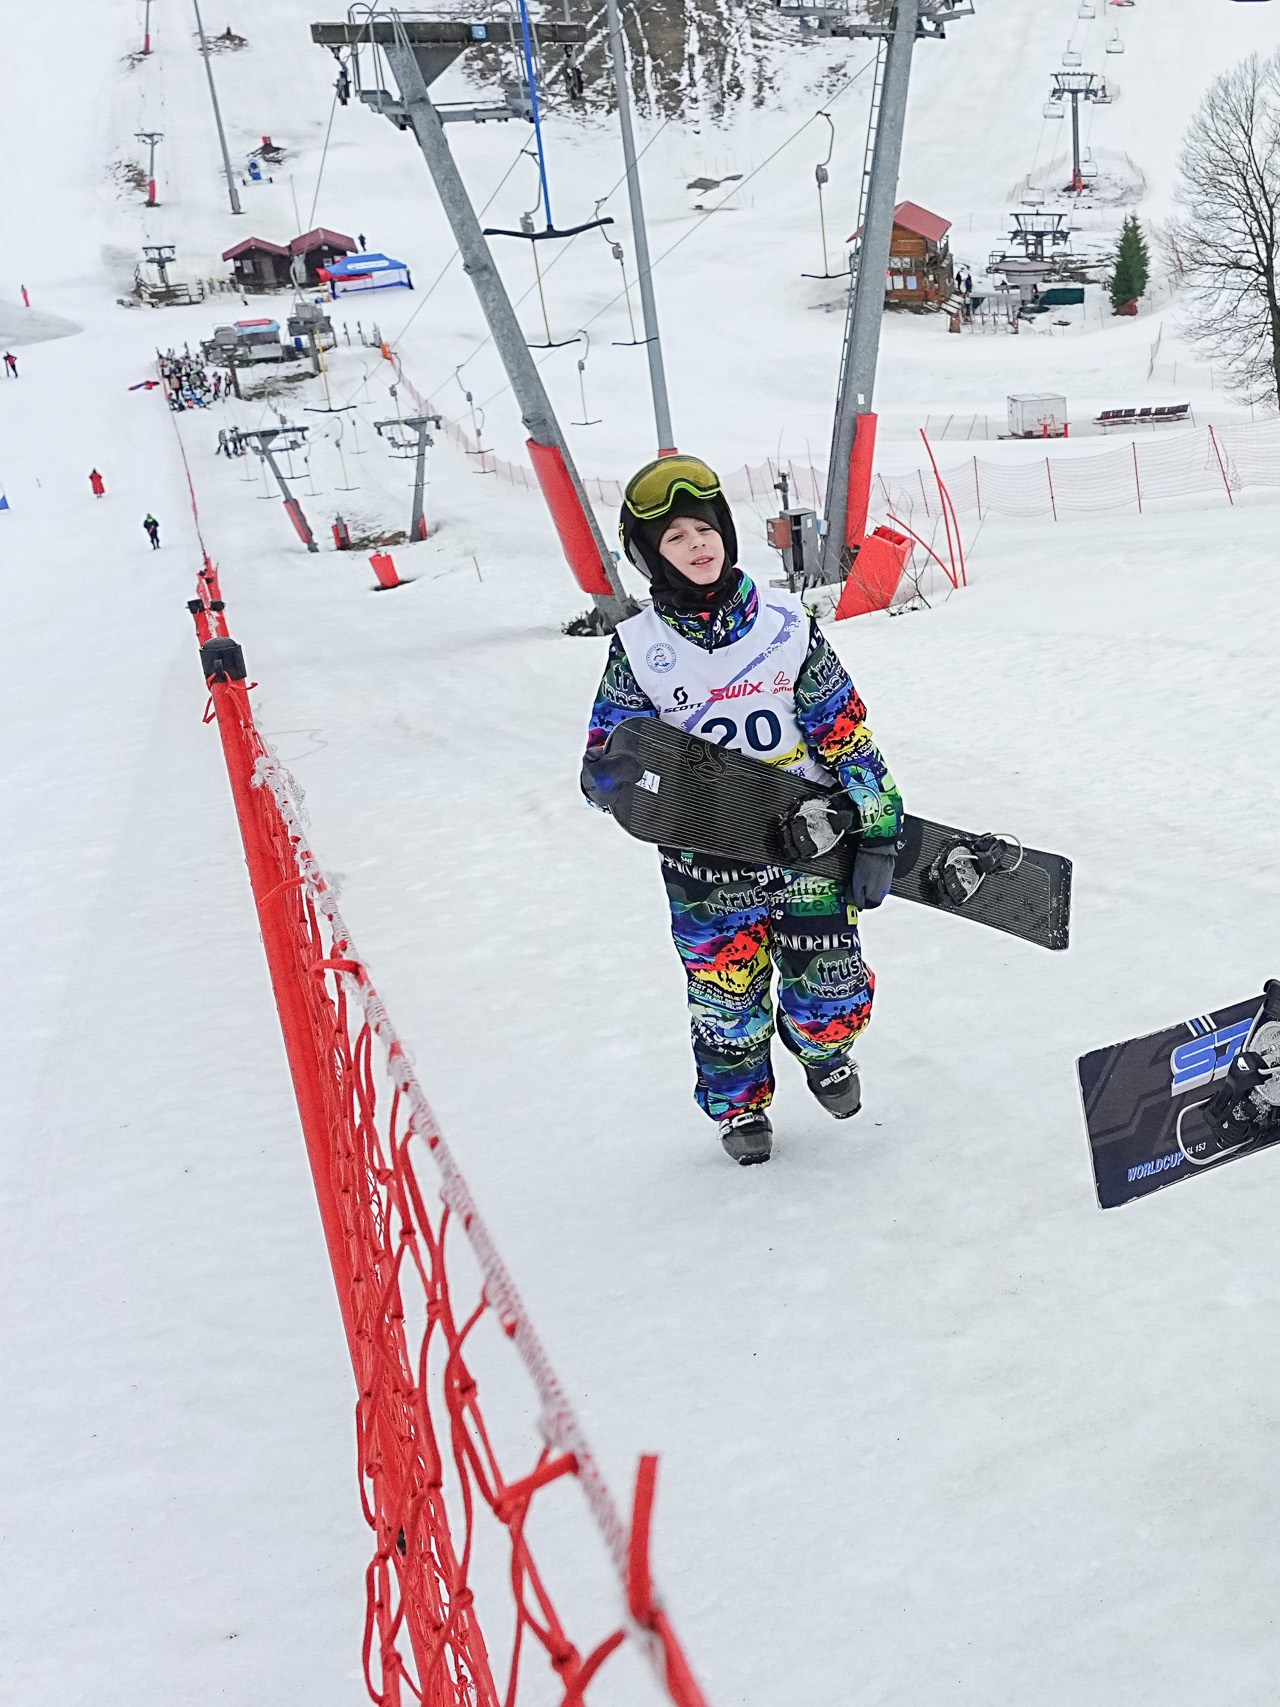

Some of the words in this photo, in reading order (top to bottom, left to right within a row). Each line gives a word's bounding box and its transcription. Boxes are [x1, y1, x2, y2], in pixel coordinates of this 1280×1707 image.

[663, 702, 703, 714] SCOTT
[700, 709, 782, 754] 20
[1127, 1151, 1185, 1182] WORLDCUP
